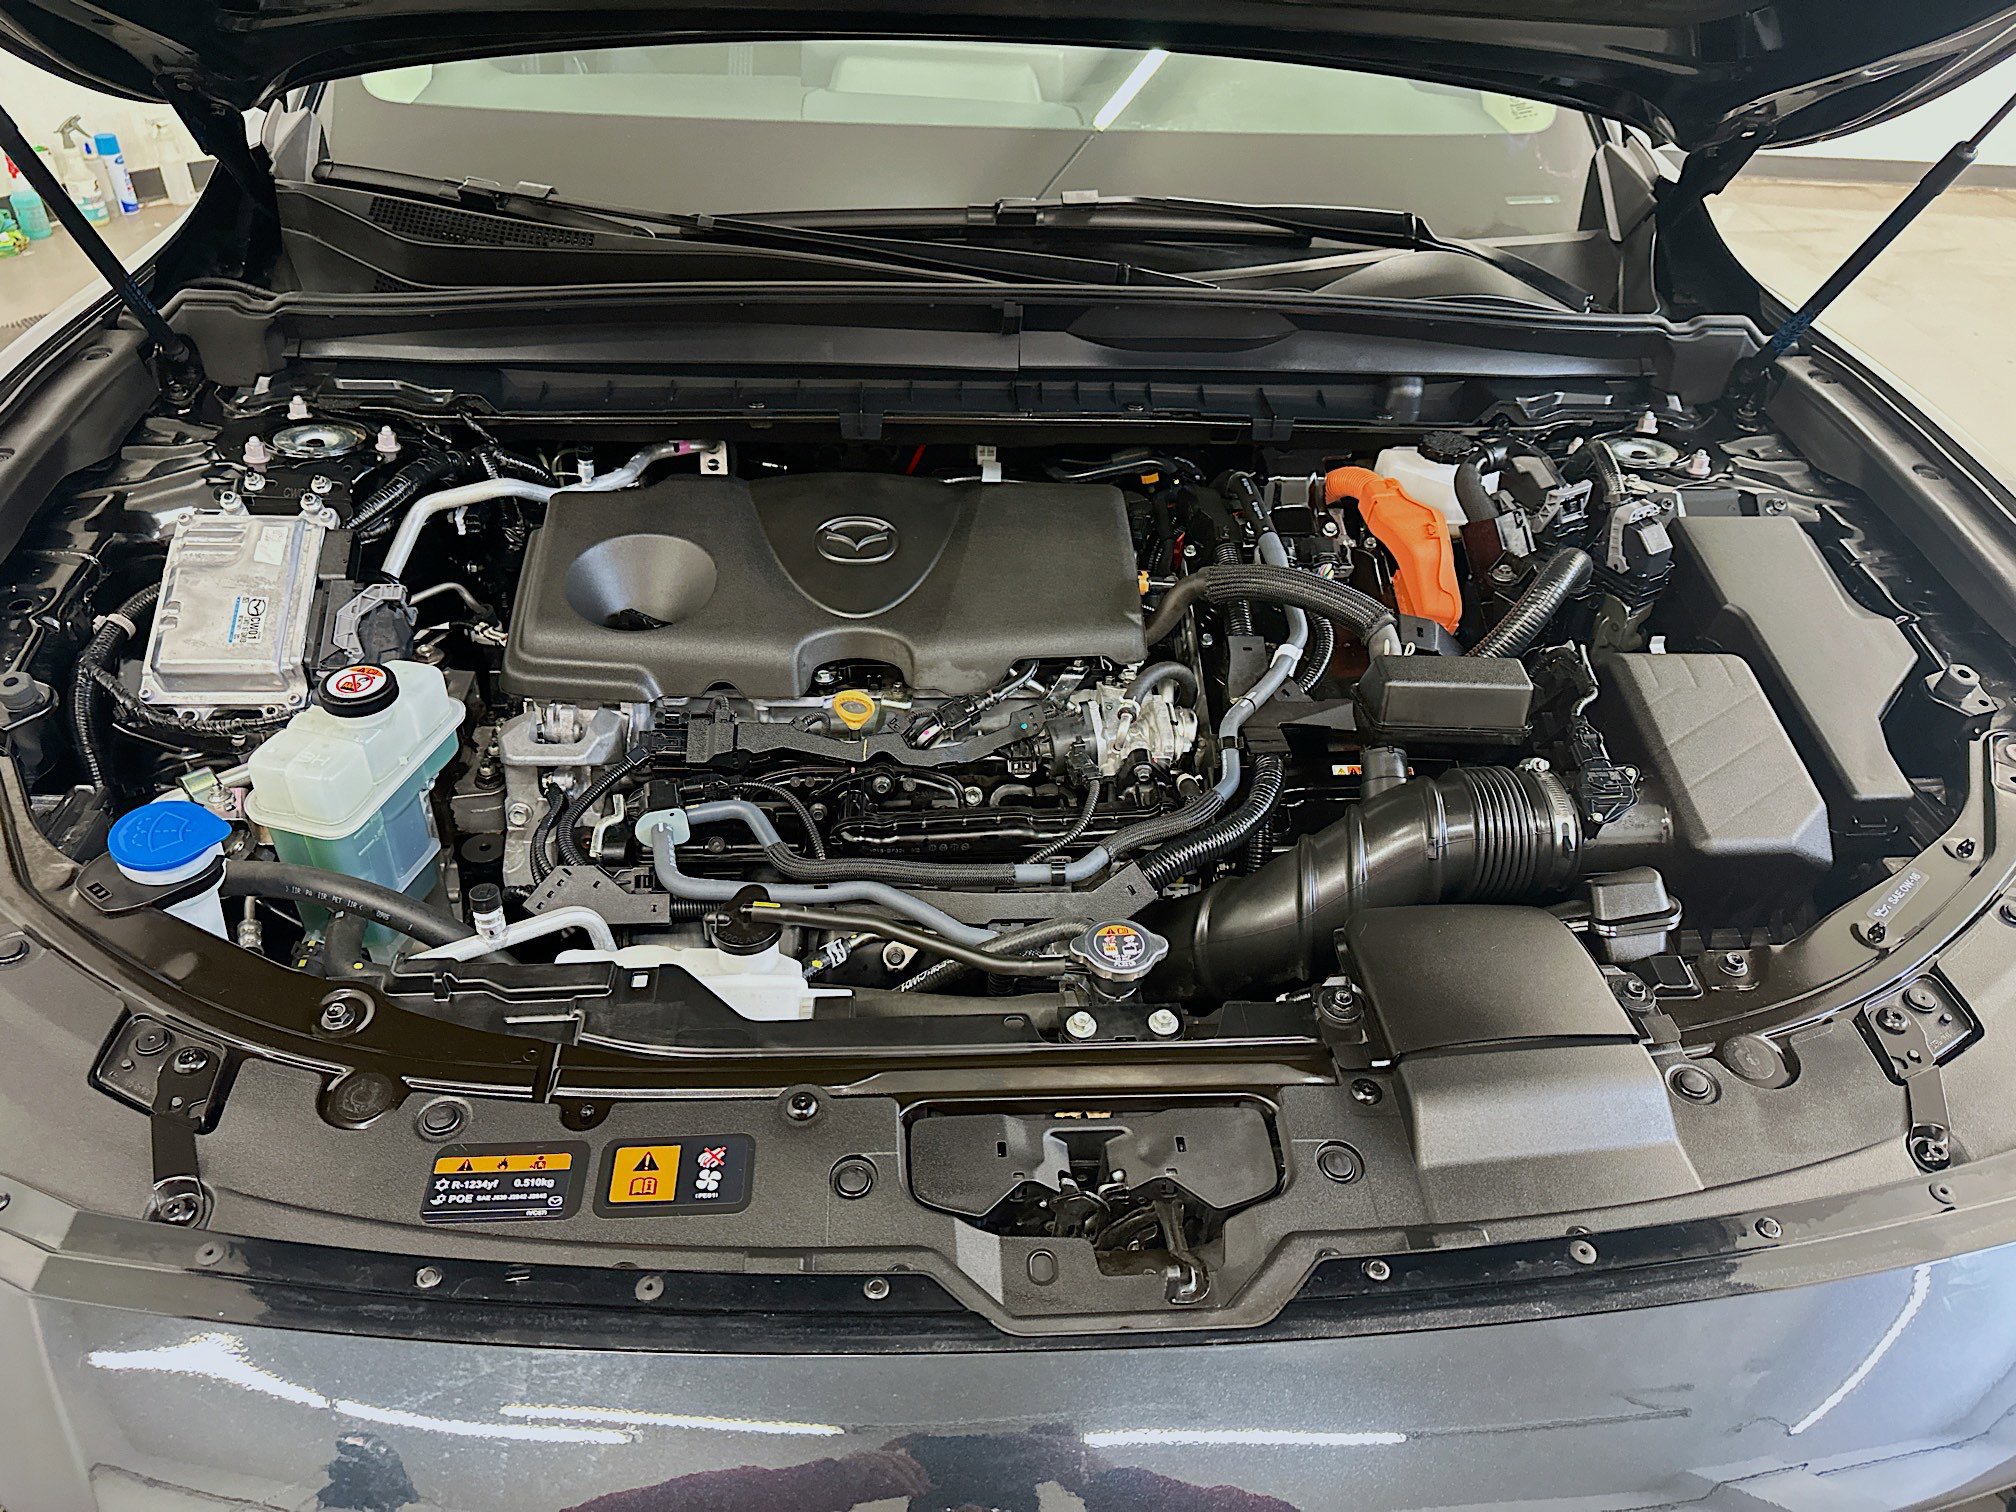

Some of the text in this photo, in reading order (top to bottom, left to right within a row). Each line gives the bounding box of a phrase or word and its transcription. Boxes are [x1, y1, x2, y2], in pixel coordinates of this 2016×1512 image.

[247, 617, 261, 639] CW01
[1888, 872, 1921, 904] SAE 0W-16
[451, 1178, 555, 1190] R-1234yf 0.510kg
[447, 1194, 474, 1204] POE
